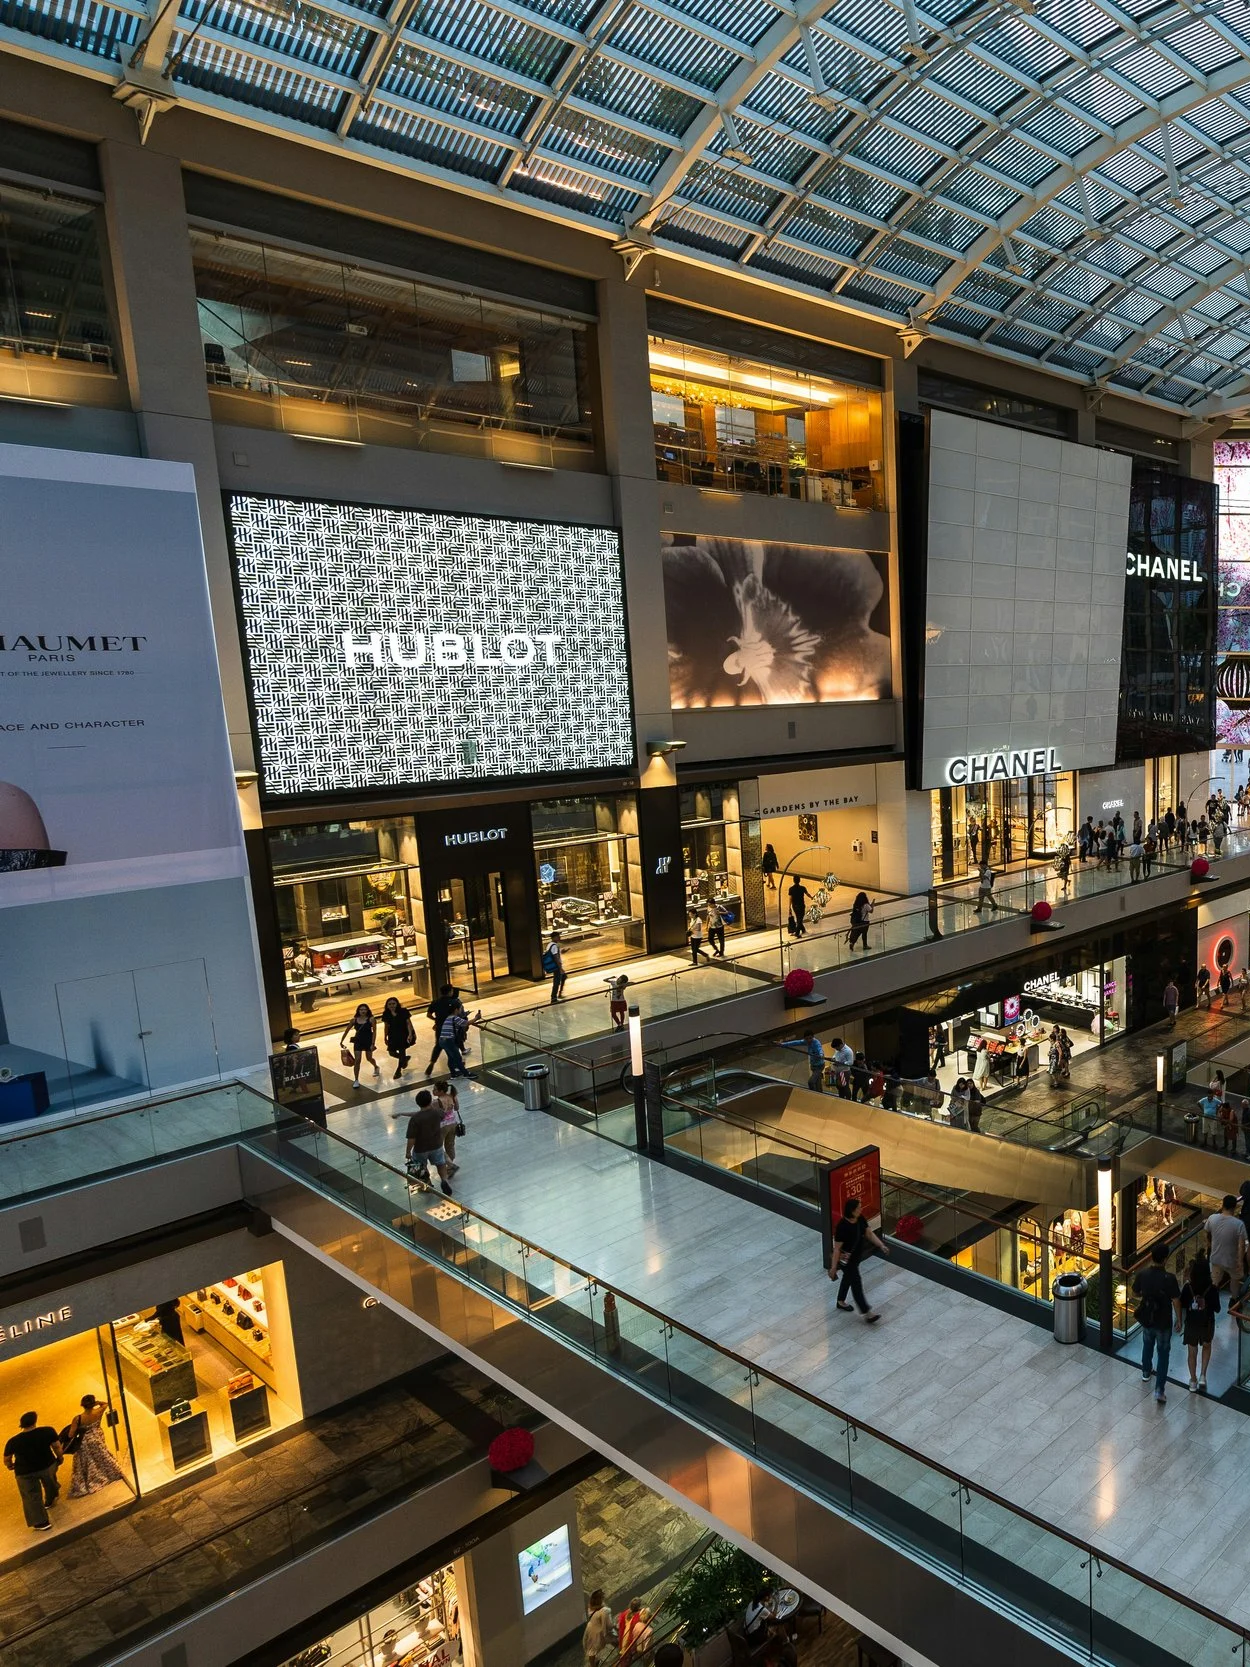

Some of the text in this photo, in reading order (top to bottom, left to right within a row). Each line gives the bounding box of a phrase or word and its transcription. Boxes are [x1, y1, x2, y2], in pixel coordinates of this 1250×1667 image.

[1126, 552, 1203, 582] CHANEL
[28, 654, 76, 662] PARIS
[343, 632, 563, 667] HUBLOT
[30, 722, 60, 731] AND
[64, 719, 145, 730] CHARACTER
[949, 748, 1062, 784] CHANEL
[763, 796, 859, 815] GARDENS BY THE BAY
[445, 828, 508, 847] HUBLOT
[1024, 971, 1060, 991] CHANEL
[284, 1071, 311, 1082] BALLY
